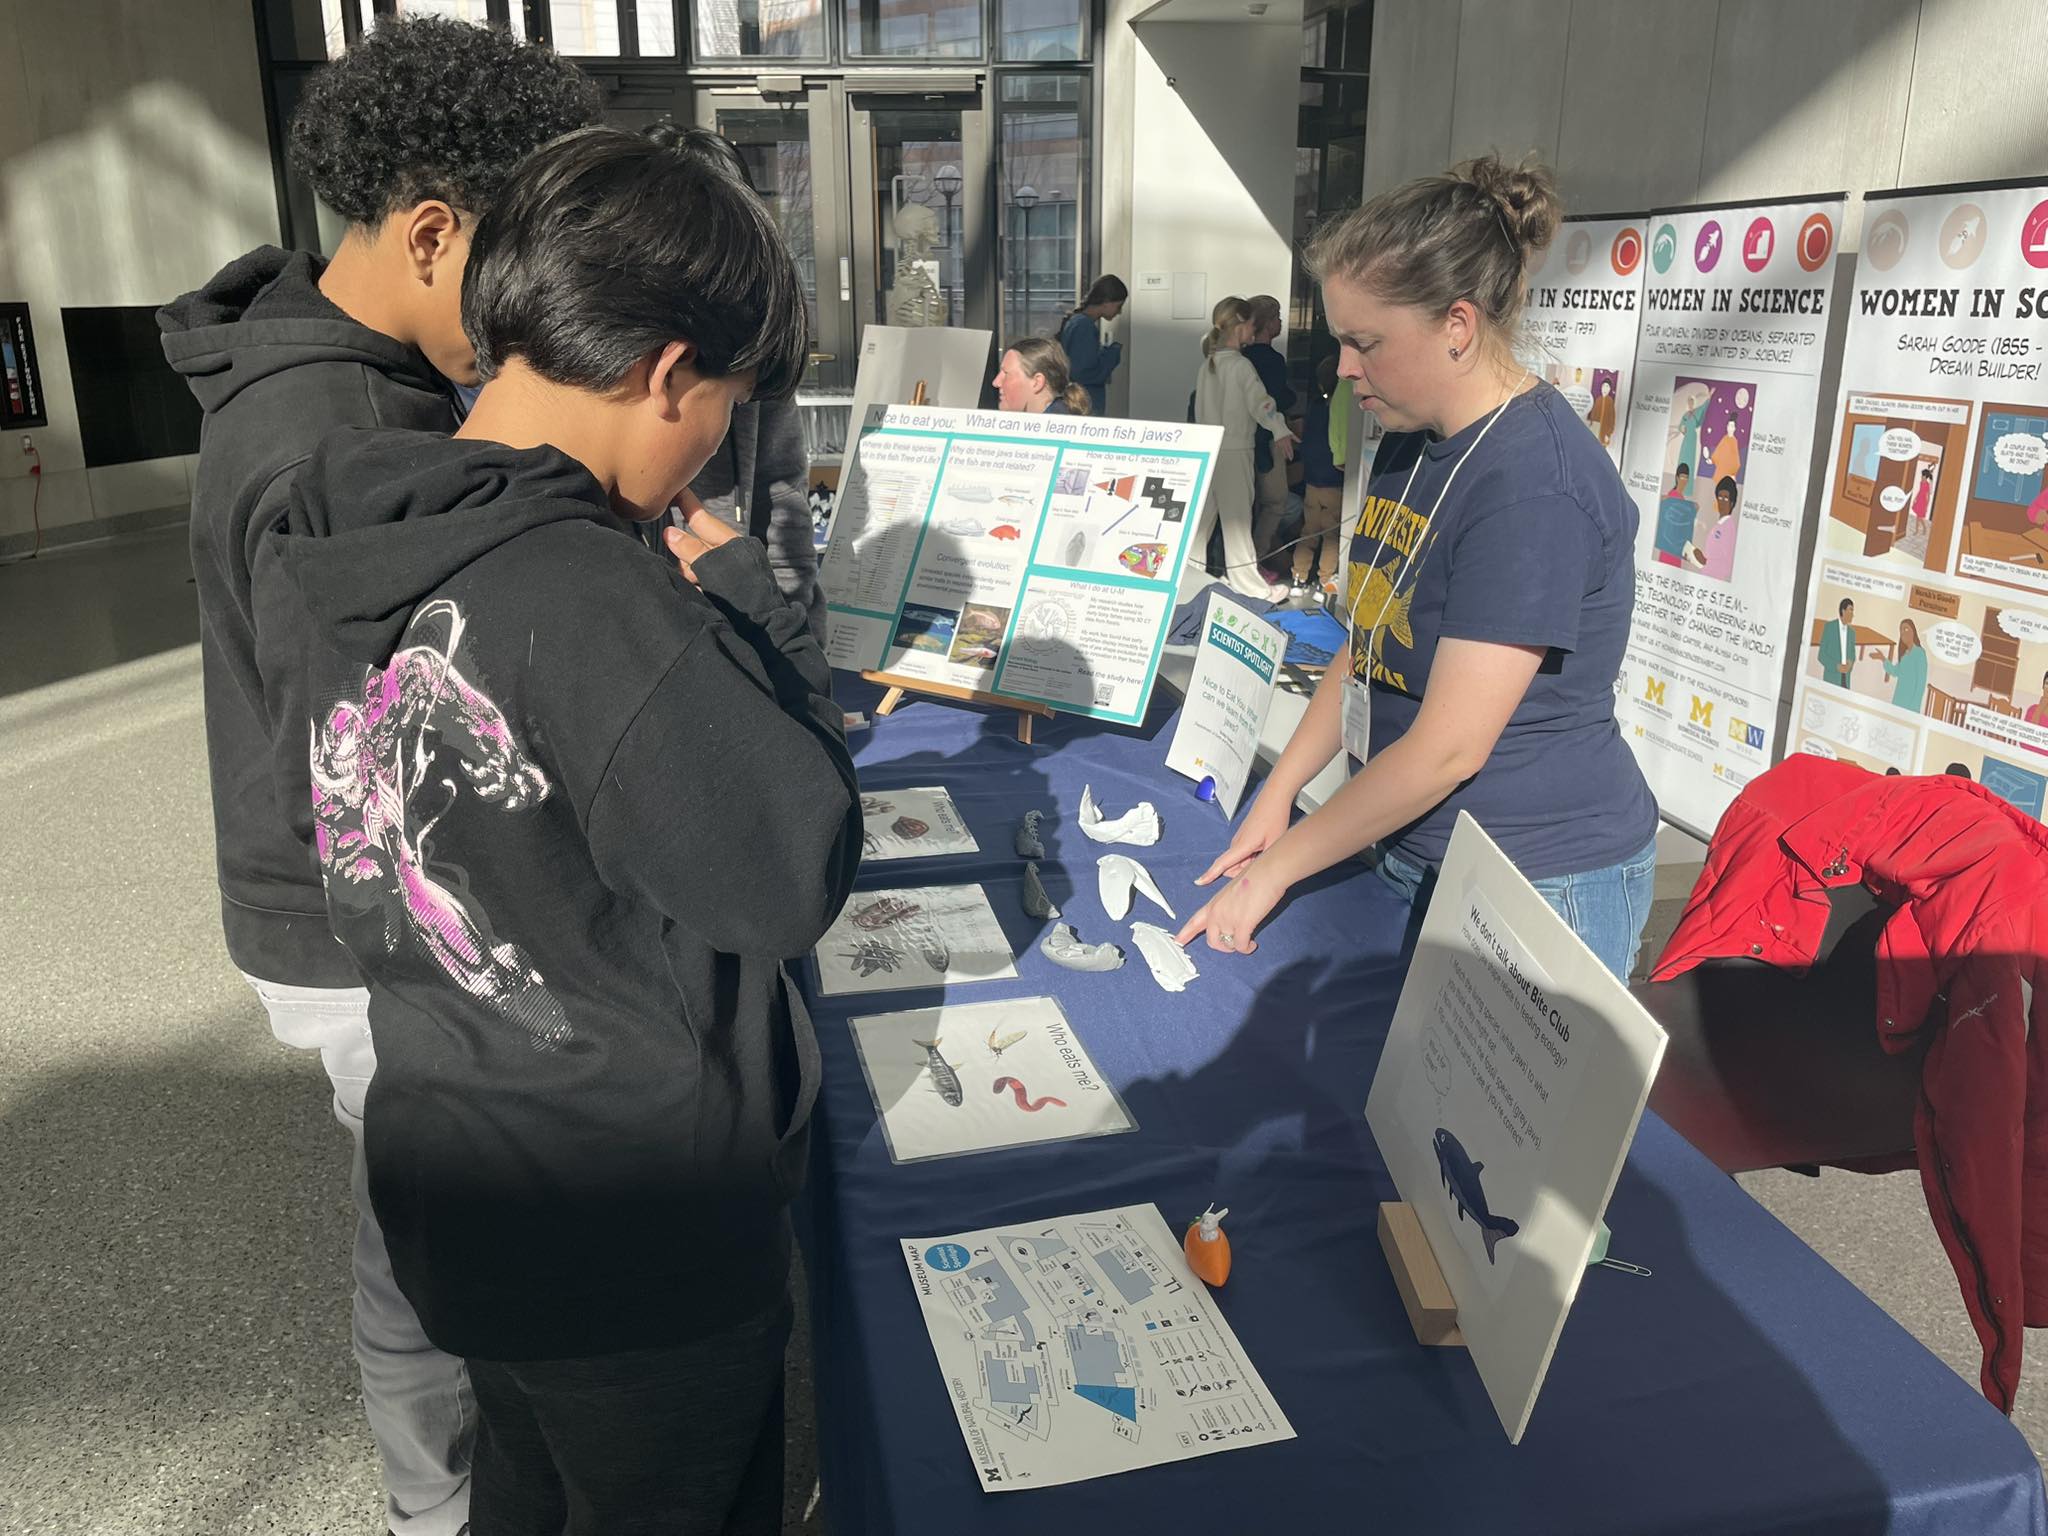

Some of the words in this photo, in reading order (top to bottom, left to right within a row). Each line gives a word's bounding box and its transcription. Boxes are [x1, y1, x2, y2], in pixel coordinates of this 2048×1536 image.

[1539, 288, 1557, 308] IN
[1562, 288, 1635, 311] SCIENCE
[1648, 288, 1705, 311] WOMEN
[1712, 289, 1732, 312] IN
[1739, 288, 1824, 314] SCIENCE
[1860, 288, 1959, 317] WOMEN
[1970, 289, 2005, 318] IN
[1719, 329, 1730, 340] BY
[1768, 332, 1815, 346] SEPARATED
[1898, 334, 1938, 352] SARAH
[1942, 335, 1987, 354] GOODE
[1991, 338, 2030, 356] (1855
[1930, 358, 1973, 377] DREAM
[1978, 360, 2042, 381] BUILDER!
[873, 410, 897, 424] Nice
[899, 413, 910, 424] to
[912, 414, 929, 427] eat
[931, 416, 956, 430] you:
[966, 414, 996, 428] What
[999, 418, 1020, 431] can
[1023, 421, 1041, 432] we
[1045, 420, 1077, 435] learn
[1080, 424, 1109, 438] from
[1112, 426, 1136, 441] fish
[1140, 428, 1183, 443] jaws?
[1636, 570, 1653, 584] SING
[1656, 576, 1670, 588] THE
[1671, 580, 1695, 597] POWER
[1696, 588, 1708, 600] OF
[1670, 610, 1686, 626] THEY
[1688, 619, 1724, 639] CHANGED
[1725, 631, 1741, 646] THE
[1743, 637, 1775, 658] WORLD!
[1696, 604, 1747, 631] ENGINEERING
[1749, 623, 1767, 636] AND
[1212, 628, 1244, 655] SCIENTIST
[1244, 646, 1273, 677] SPOTLIGHT
[1078, 667, 1093, 677] Read
[1202, 676, 1218, 691] Nice
[1645, 676, 1666, 706] M
[1690, 694, 1714, 728] M
[1470, 904, 1480, 928] We
[1480, 922, 1496, 951] don't
[1496, 943, 1509, 968] talk
[1508, 962, 1530, 995] about
[1530, 986, 1548, 1017] Bite
[1550, 1009, 1570, 1043] Club
[1521, 1005, 1541, 1039] feeding
[1540, 1033, 1567, 1069] ecology?
[1046, 1023, 1067, 1046] Who
[1060, 1048, 1081, 1068] eats
[1072, 1071, 1100, 1091] me?
[1512, 1050, 1528, 1076] jaws)
[1534, 1078, 1550, 1105] what
[1496, 1076, 1514, 1107] species
[1512, 1101, 1527, 1129] (grey
[1502, 1115, 1524, 1148] correct!
[908, 1245, 920, 1261] MAP
[974, 1246, 989, 1256] 2
[914, 1263, 932, 1296] MUSEUM
[1163, 1276, 1183, 1294] LL
[959, 1400, 977, 1427] NATURAL
[969, 1427, 980, 1437] OF
[972, 1436, 990, 1464] MUSEUM
[983, 1466, 1002, 1483] M
